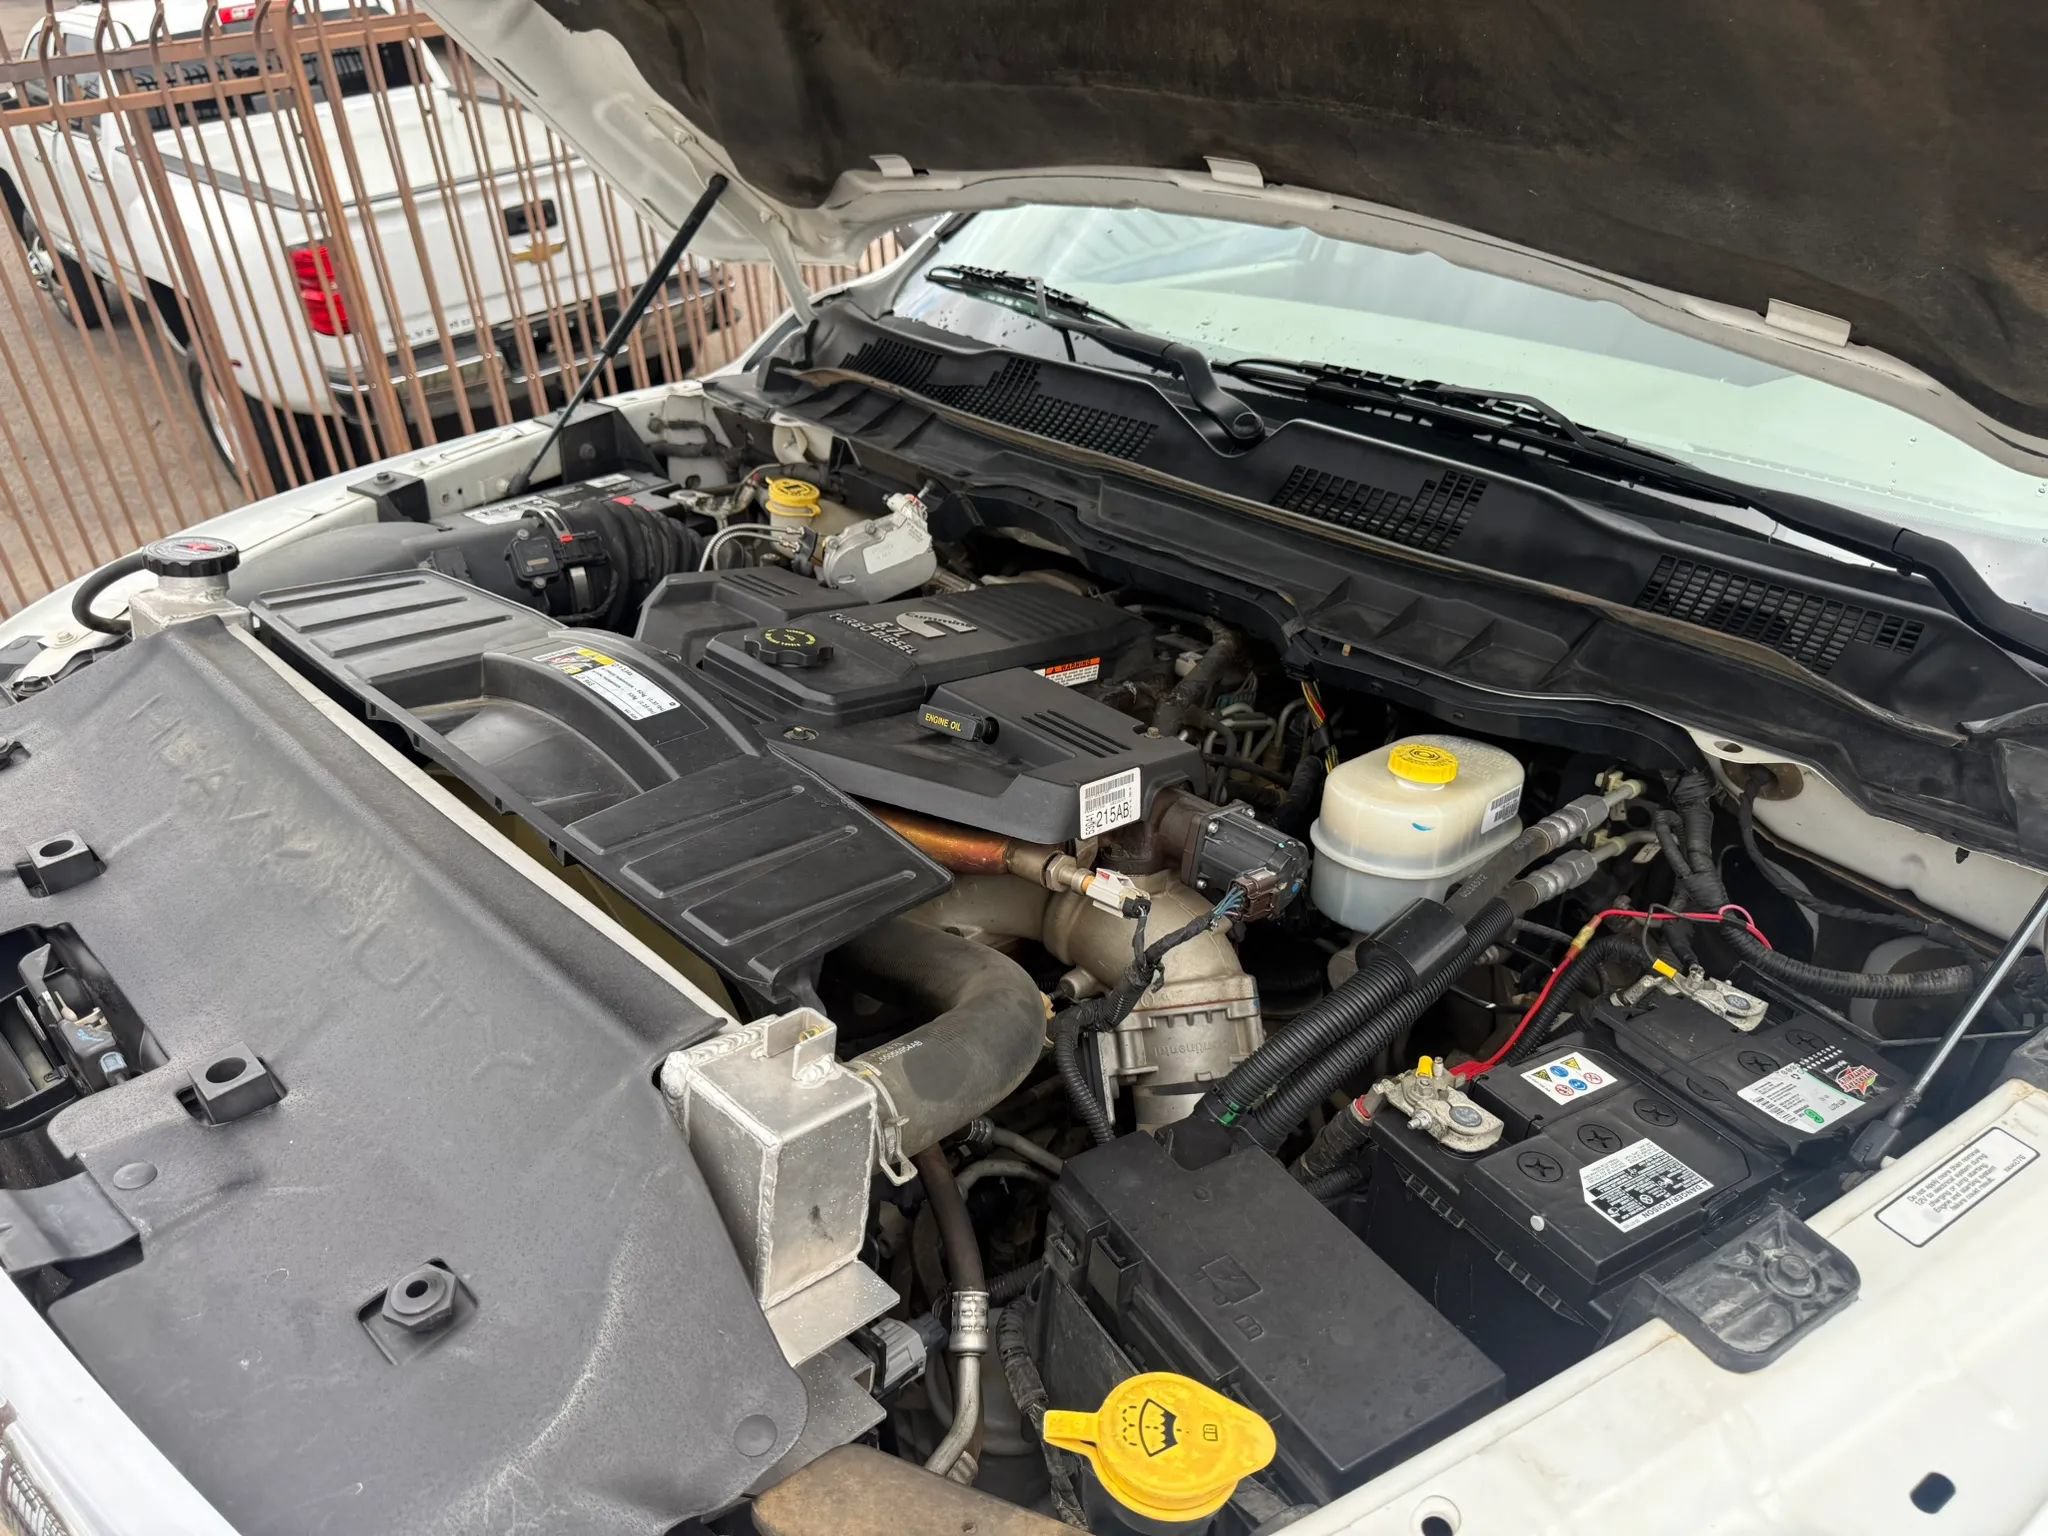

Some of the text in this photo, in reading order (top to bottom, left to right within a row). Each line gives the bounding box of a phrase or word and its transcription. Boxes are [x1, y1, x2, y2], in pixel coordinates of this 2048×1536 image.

[873, 620, 912, 638] 6.7L
[905, 611, 977, 629] Cummins
[829, 612, 919, 655] TURBO DIESEL
[925, 712, 962, 732] ENGINE OIL
[1096, 801, 1130, 828] 215AB
[1926, 1180, 1940, 1191] apply
[1938, 1170, 1952, 1180] more
[1641, 1182, 1704, 1219] DANGER/POISON
[1915, 1198, 1927, 1206] 12V
